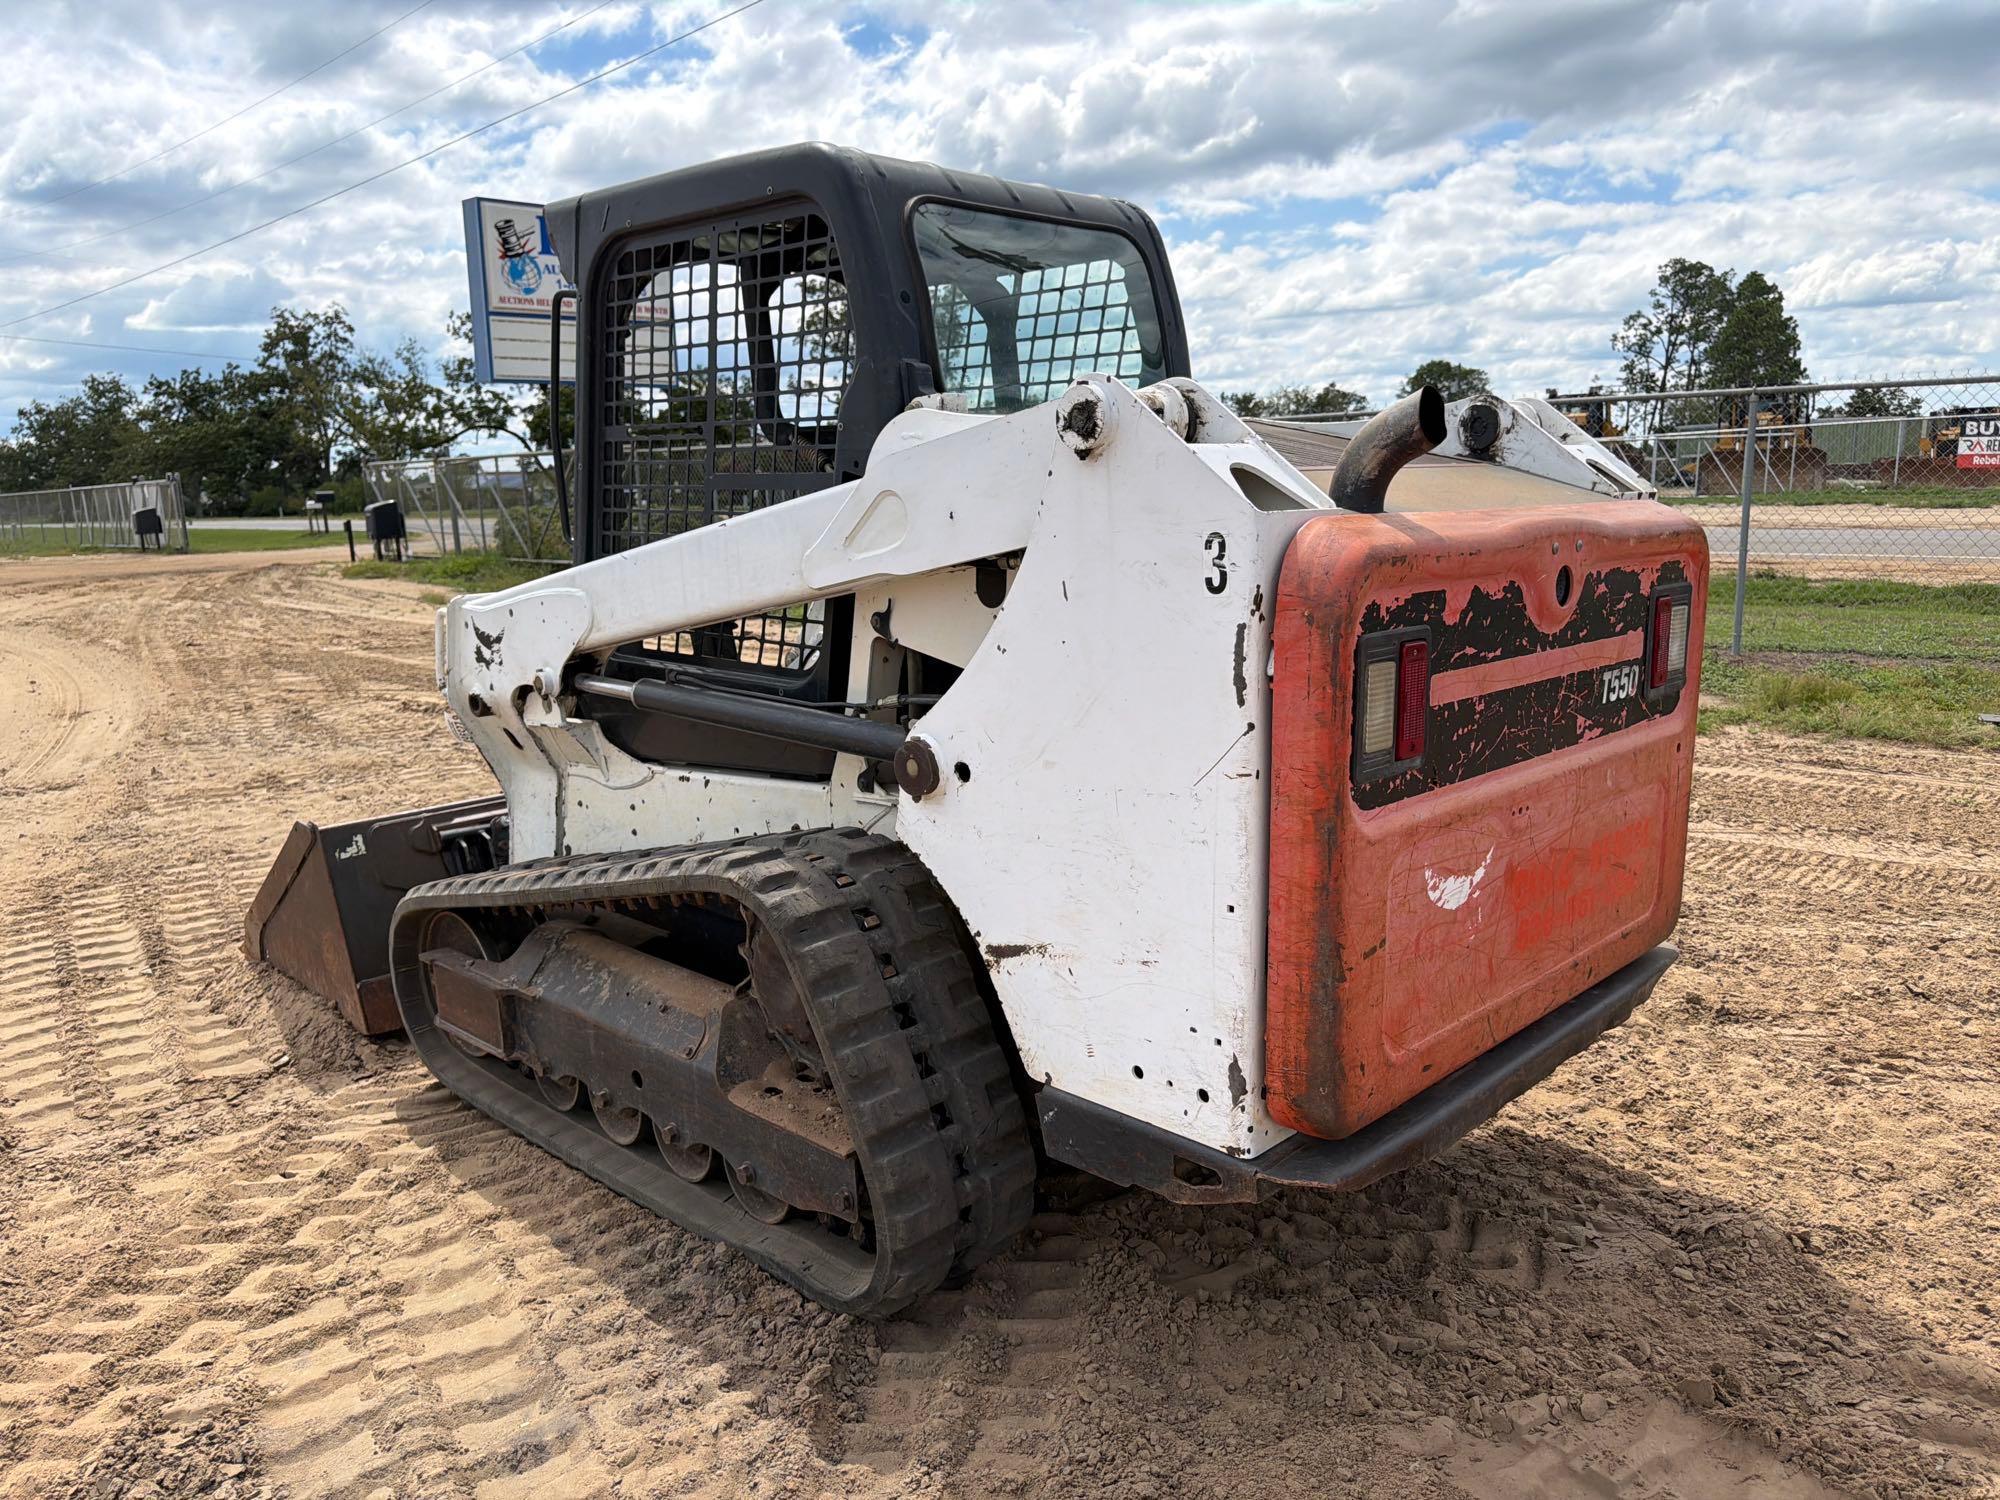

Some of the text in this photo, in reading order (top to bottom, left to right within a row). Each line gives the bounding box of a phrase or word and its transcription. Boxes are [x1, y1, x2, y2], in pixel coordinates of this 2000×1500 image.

[499, 296, 535, 306] AUCTIONS
[536, 298, 554, 306] HEL
[644, 305, 669, 315] MNTH
[1204, 531, 1228, 595] 3
[1602, 664, 1640, 704] T550
